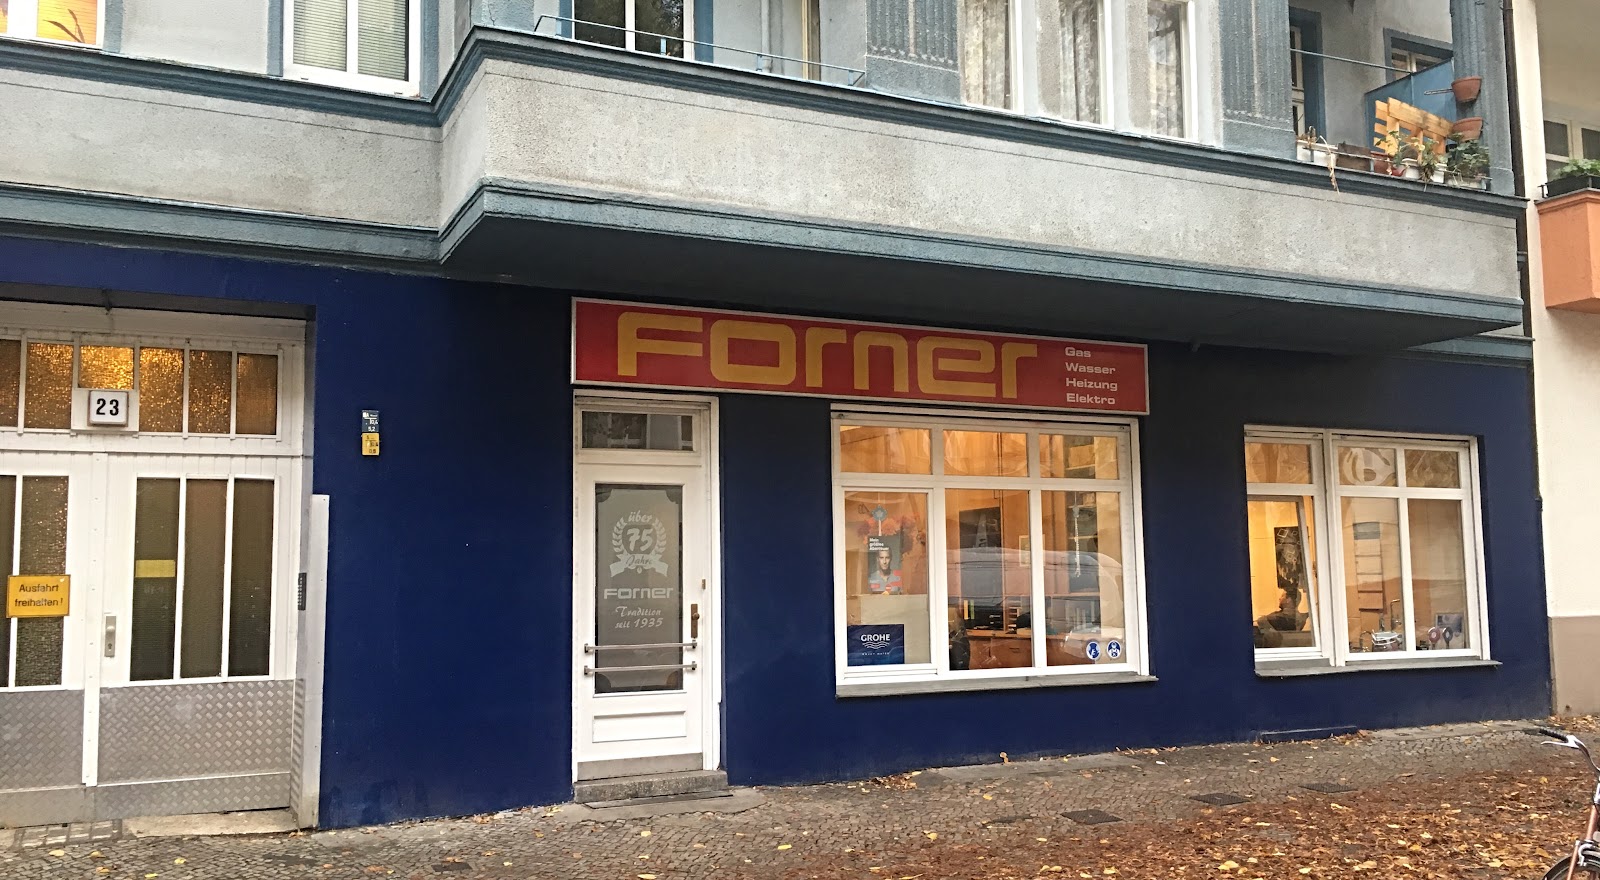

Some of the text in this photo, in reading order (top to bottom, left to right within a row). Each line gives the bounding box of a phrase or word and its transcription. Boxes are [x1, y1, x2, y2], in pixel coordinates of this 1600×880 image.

[618, 311, 1038, 399] Forner
[1065, 346, 1091, 358] Gas
[1065, 362, 1116, 374] Wasser
[1066, 377, 1118, 392] Heizung
[1066, 393, 1116, 405] Elektro
[95, 397, 120, 417] 23
[628, 510, 653, 523] über
[627, 528, 653, 552] 75
[19, 584, 59, 592] Ausfahrt
[603, 587, 674, 599] Forner
[615, 606, 662, 618] Tradition
[615, 617, 664, 629] seit 1935
[860, 633, 891, 642] GROHE
